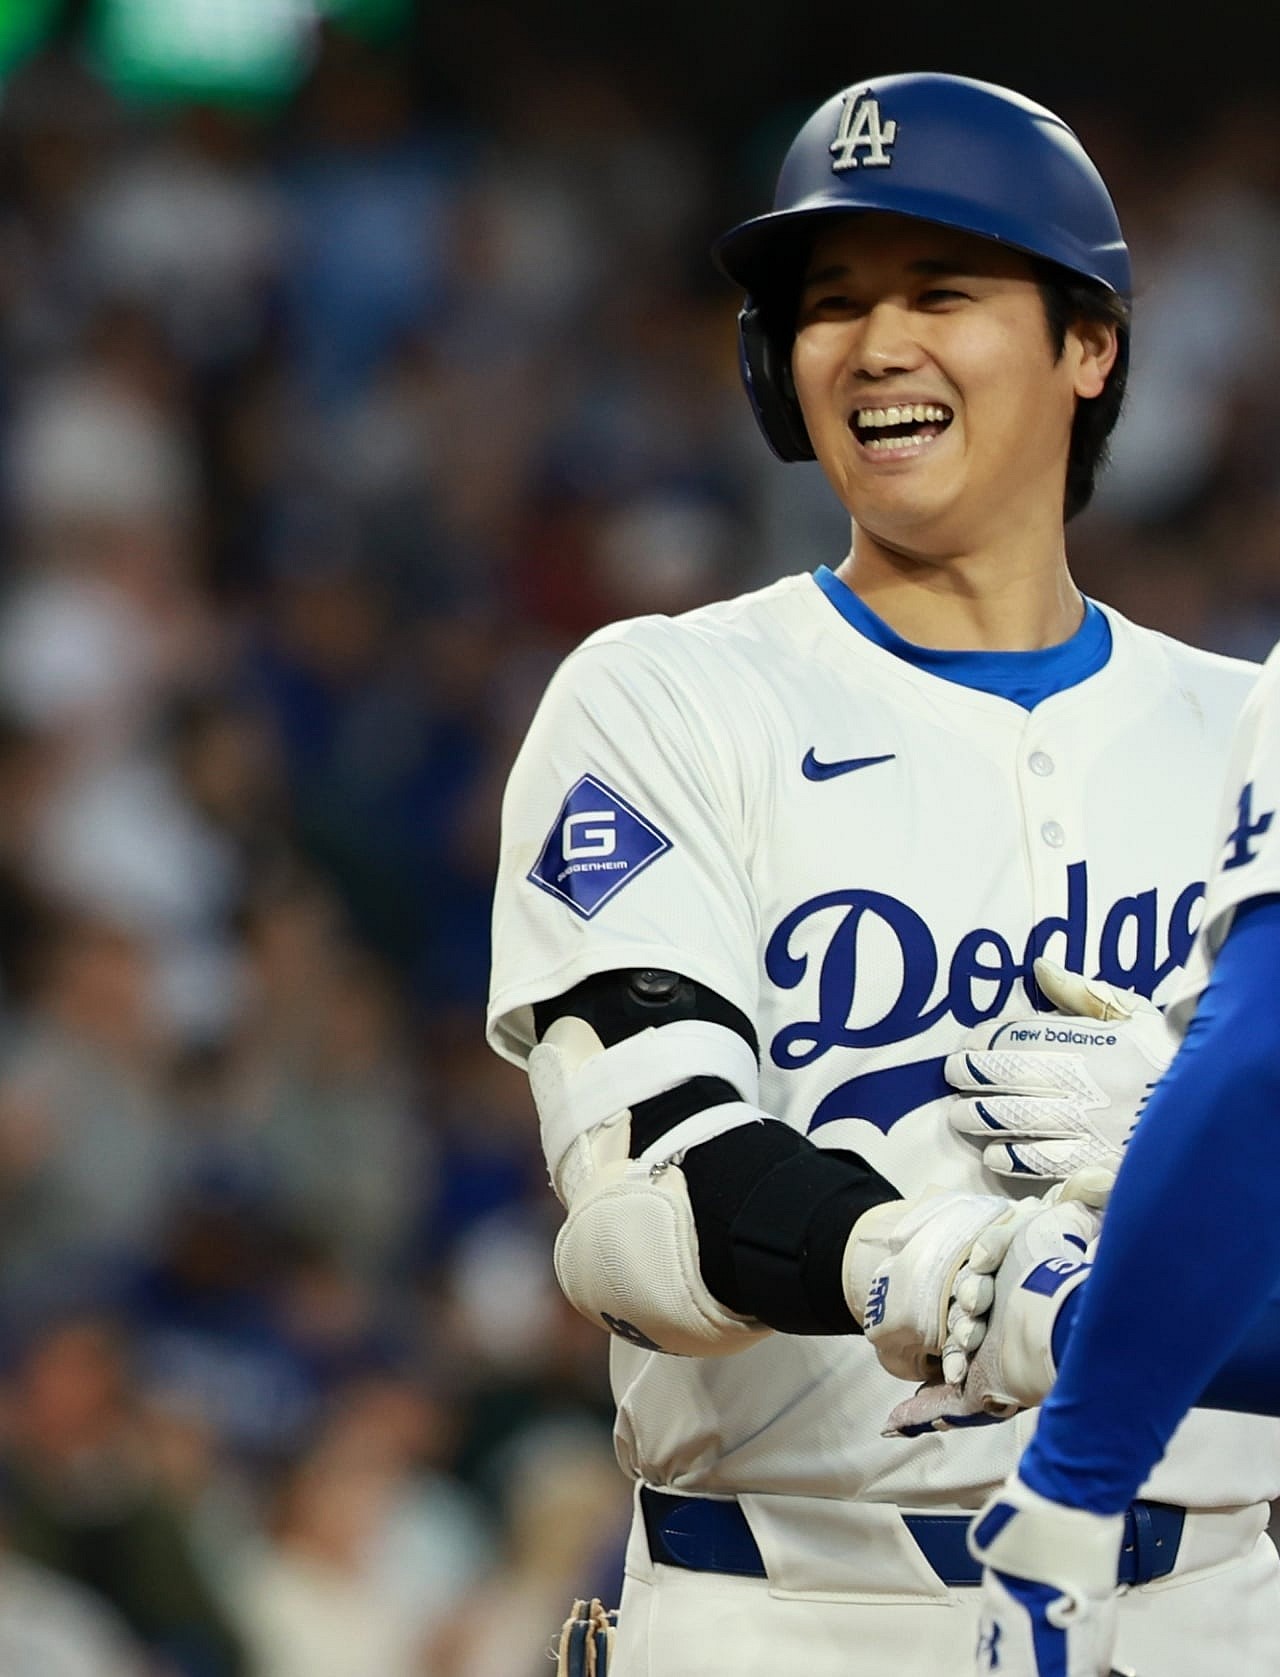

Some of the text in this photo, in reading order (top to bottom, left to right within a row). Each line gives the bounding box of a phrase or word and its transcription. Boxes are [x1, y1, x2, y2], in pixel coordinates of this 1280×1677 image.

[829, 89, 897, 170] LA
[562, 811, 616, 862] G
[1010, 1027, 1117, 1046] new balance
